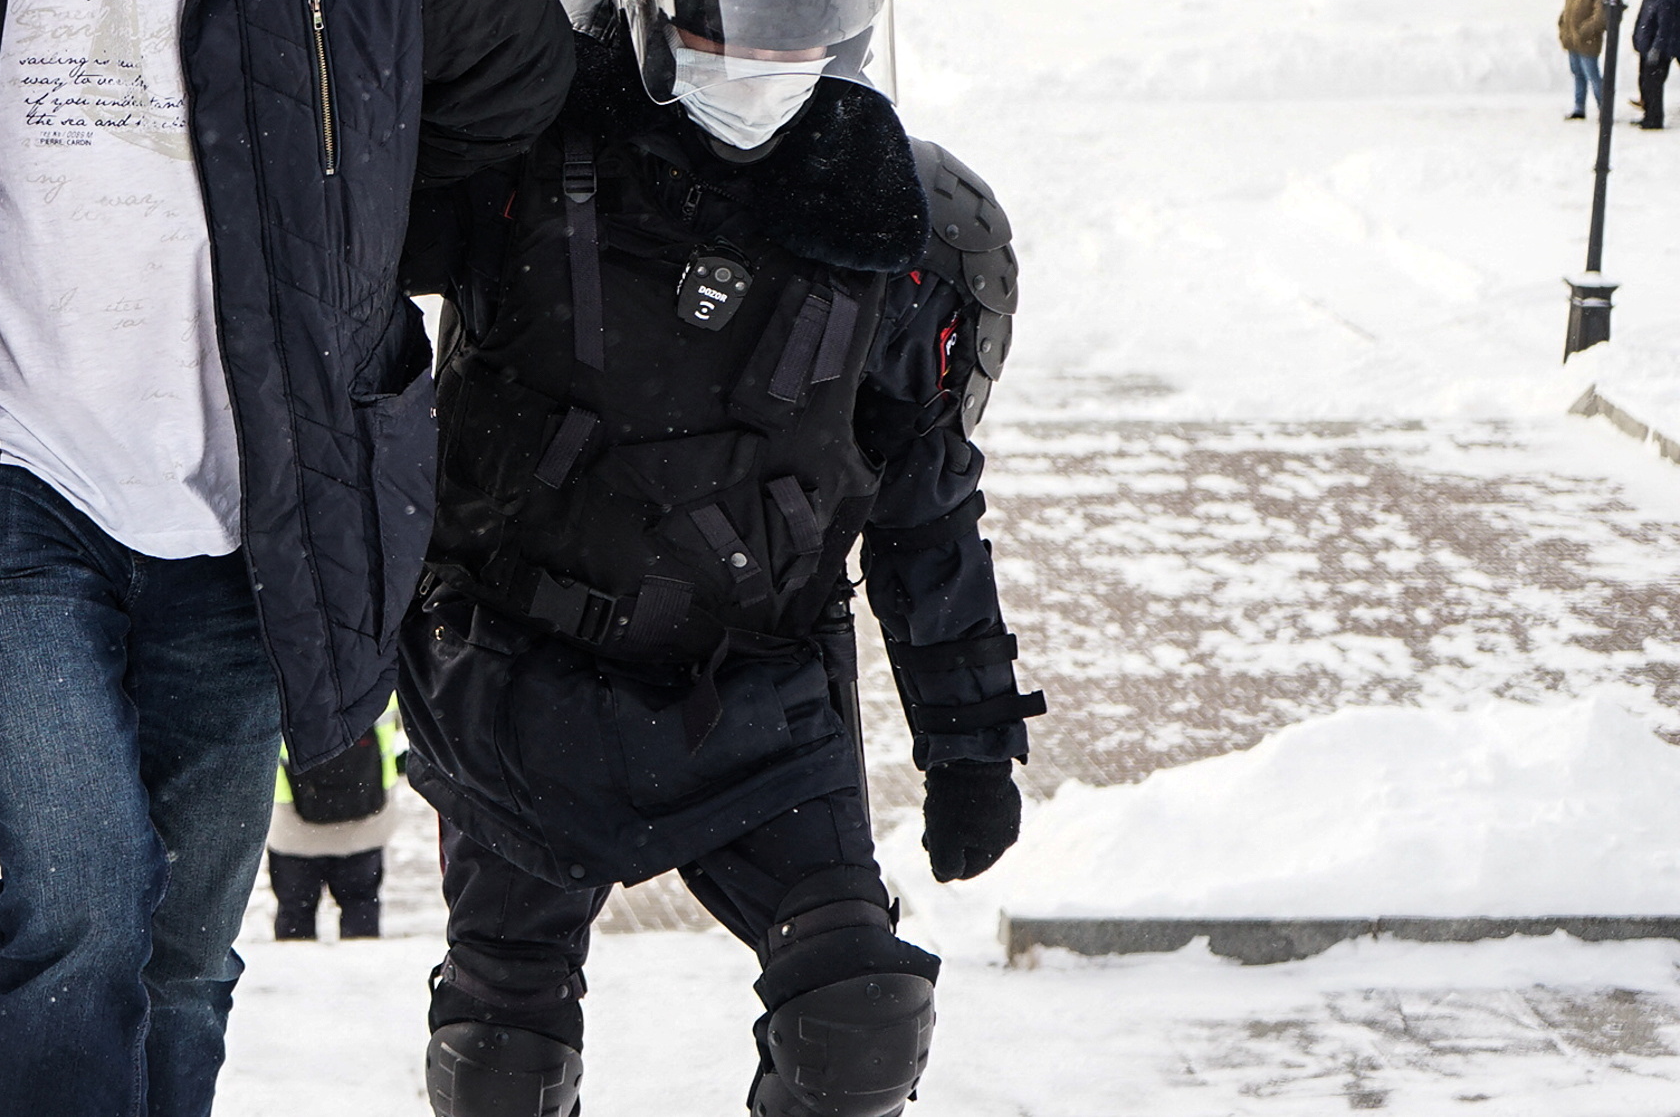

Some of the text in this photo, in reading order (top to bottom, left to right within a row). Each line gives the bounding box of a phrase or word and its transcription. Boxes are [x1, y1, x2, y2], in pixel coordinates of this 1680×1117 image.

[21, 75, 68, 92] way
[73, 74, 103, 86] to
[51, 97, 90, 113] you
[95, 93, 187, 110] undertand
[94, 114, 132, 128] and
[698, 285, 728, 303] DOZOR
